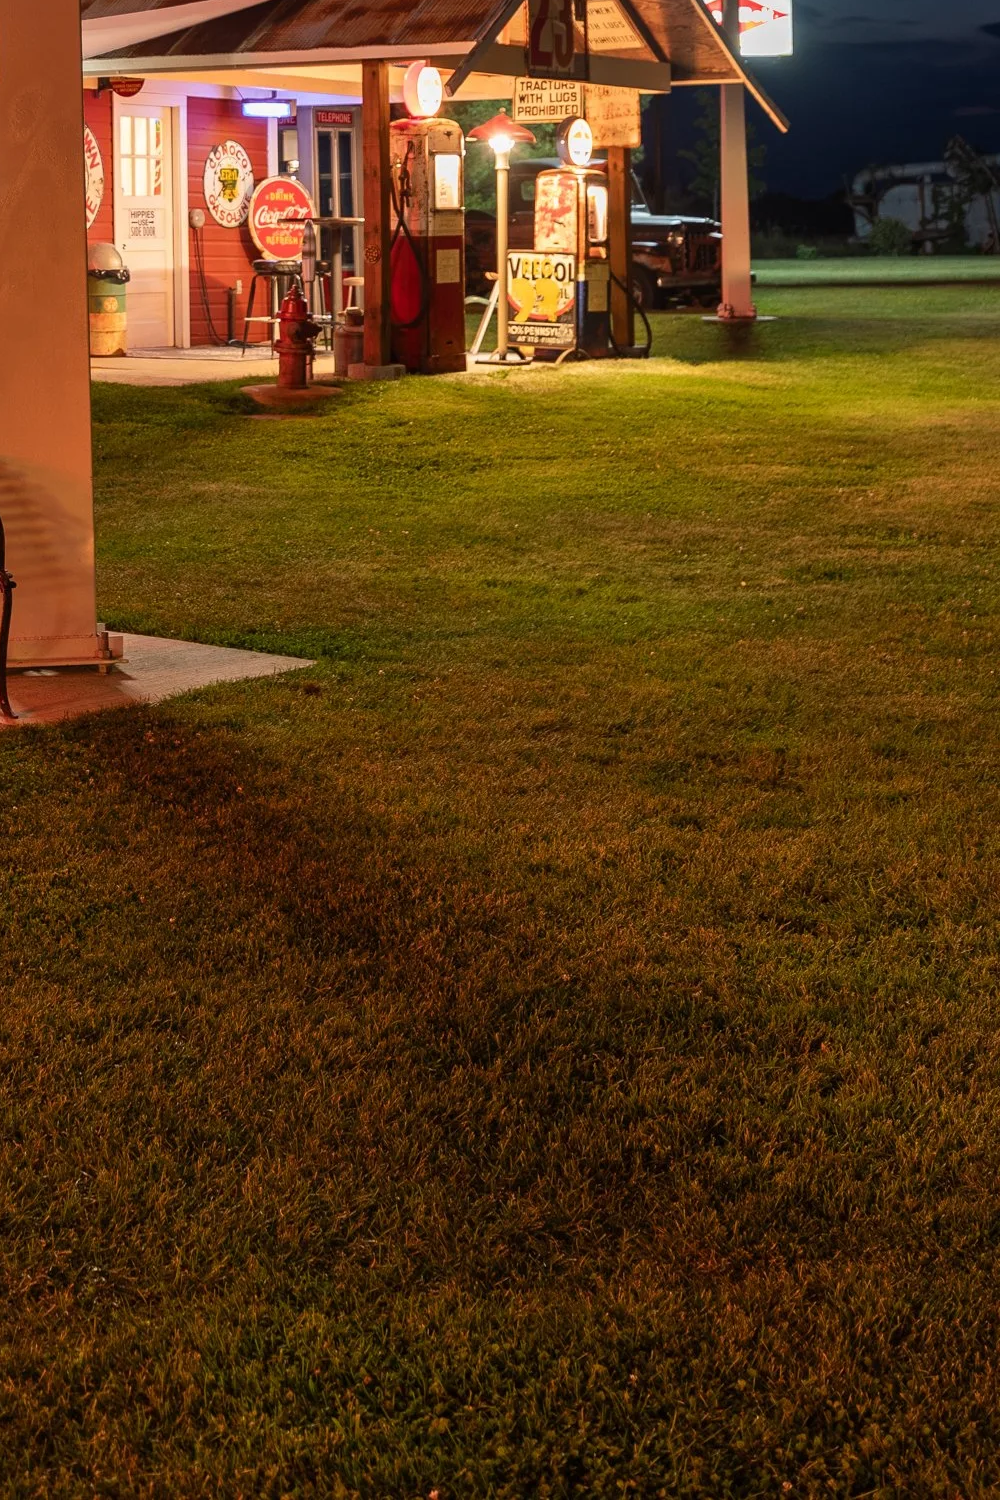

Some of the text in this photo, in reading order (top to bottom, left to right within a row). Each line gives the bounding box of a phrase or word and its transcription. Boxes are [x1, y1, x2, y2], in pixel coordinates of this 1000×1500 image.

[520, 80, 576, 92] TRACTORS
[519, 92, 577, 104] WITH LUGS
[518, 104, 579, 116] PROHIBITED
[318, 111, 352, 124] TELEPHONE
[209, 145, 248, 169] CONOCO
[269, 190, 295, 202] DRINK
[130, 210, 155, 219] HIPPIES
[130, 226, 155, 237] SIDE DOOR
